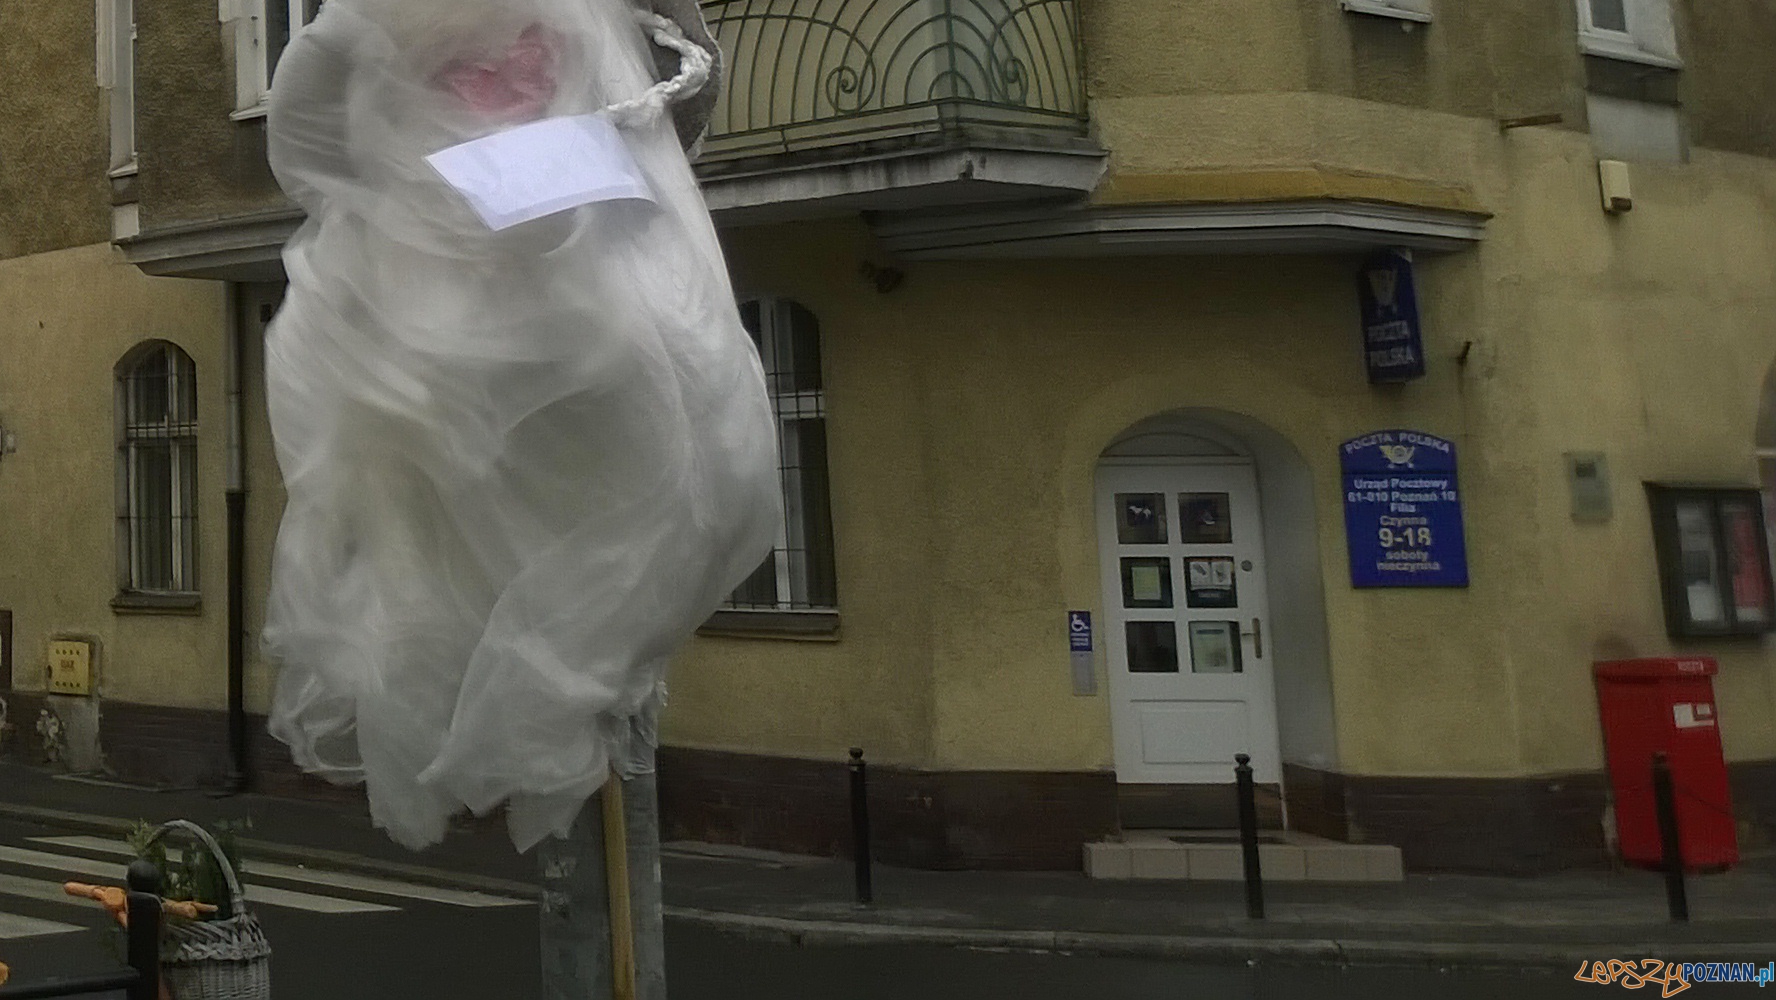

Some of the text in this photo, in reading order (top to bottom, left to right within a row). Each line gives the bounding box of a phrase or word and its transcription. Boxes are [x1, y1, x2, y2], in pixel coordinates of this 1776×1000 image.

[1345, 432, 1450, 454] POCZTA POLSKA
[1390, 478, 1447, 490] Pocztowy
[1378, 527, 1432, 548] 9-18
